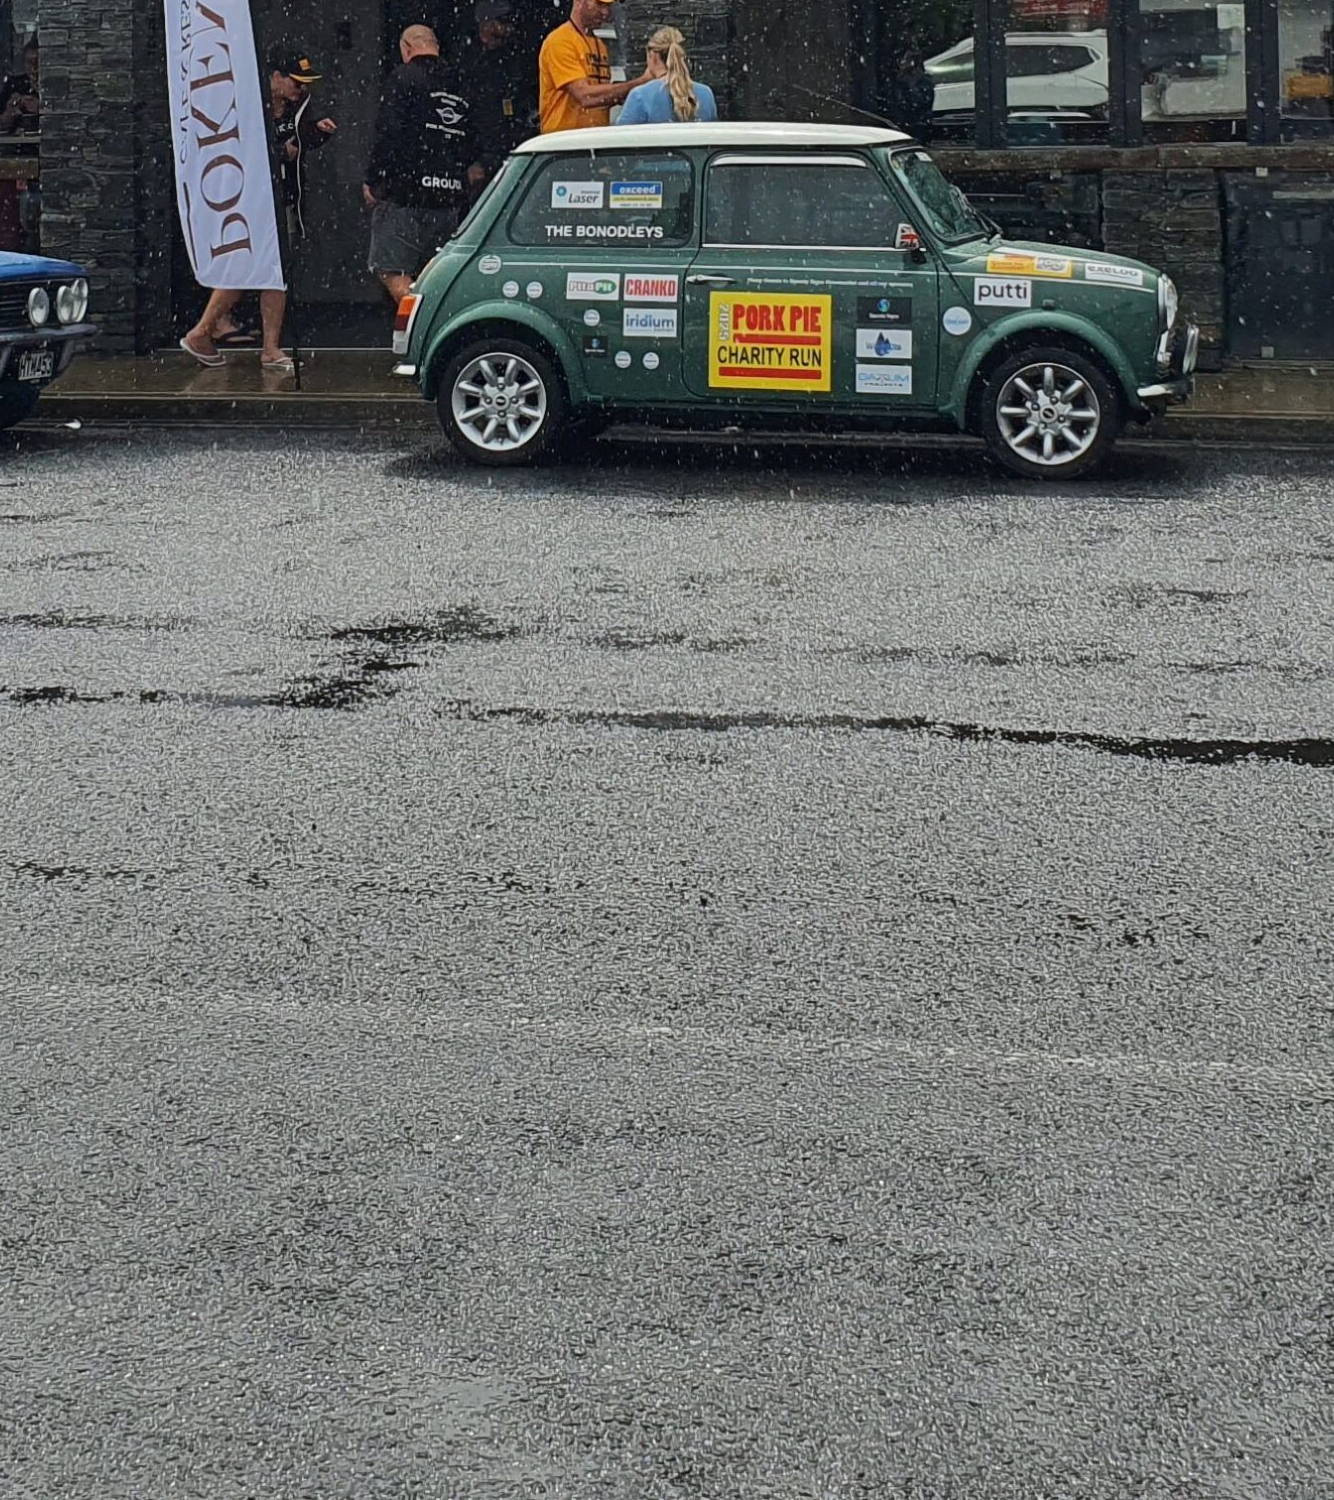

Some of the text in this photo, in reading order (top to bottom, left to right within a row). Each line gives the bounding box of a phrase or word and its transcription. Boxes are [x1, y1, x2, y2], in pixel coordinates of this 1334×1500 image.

[568, 193, 599, 204] Laser
[545, 225, 664, 238] THE BONODLEYS
[978, 283, 1028, 301] putti
[626, 313, 675, 328] iridium
[719, 303, 730, 341] 2025
[733, 303, 822, 333] PORK PIE
[717, 345, 822, 367] CHARITY RUN
